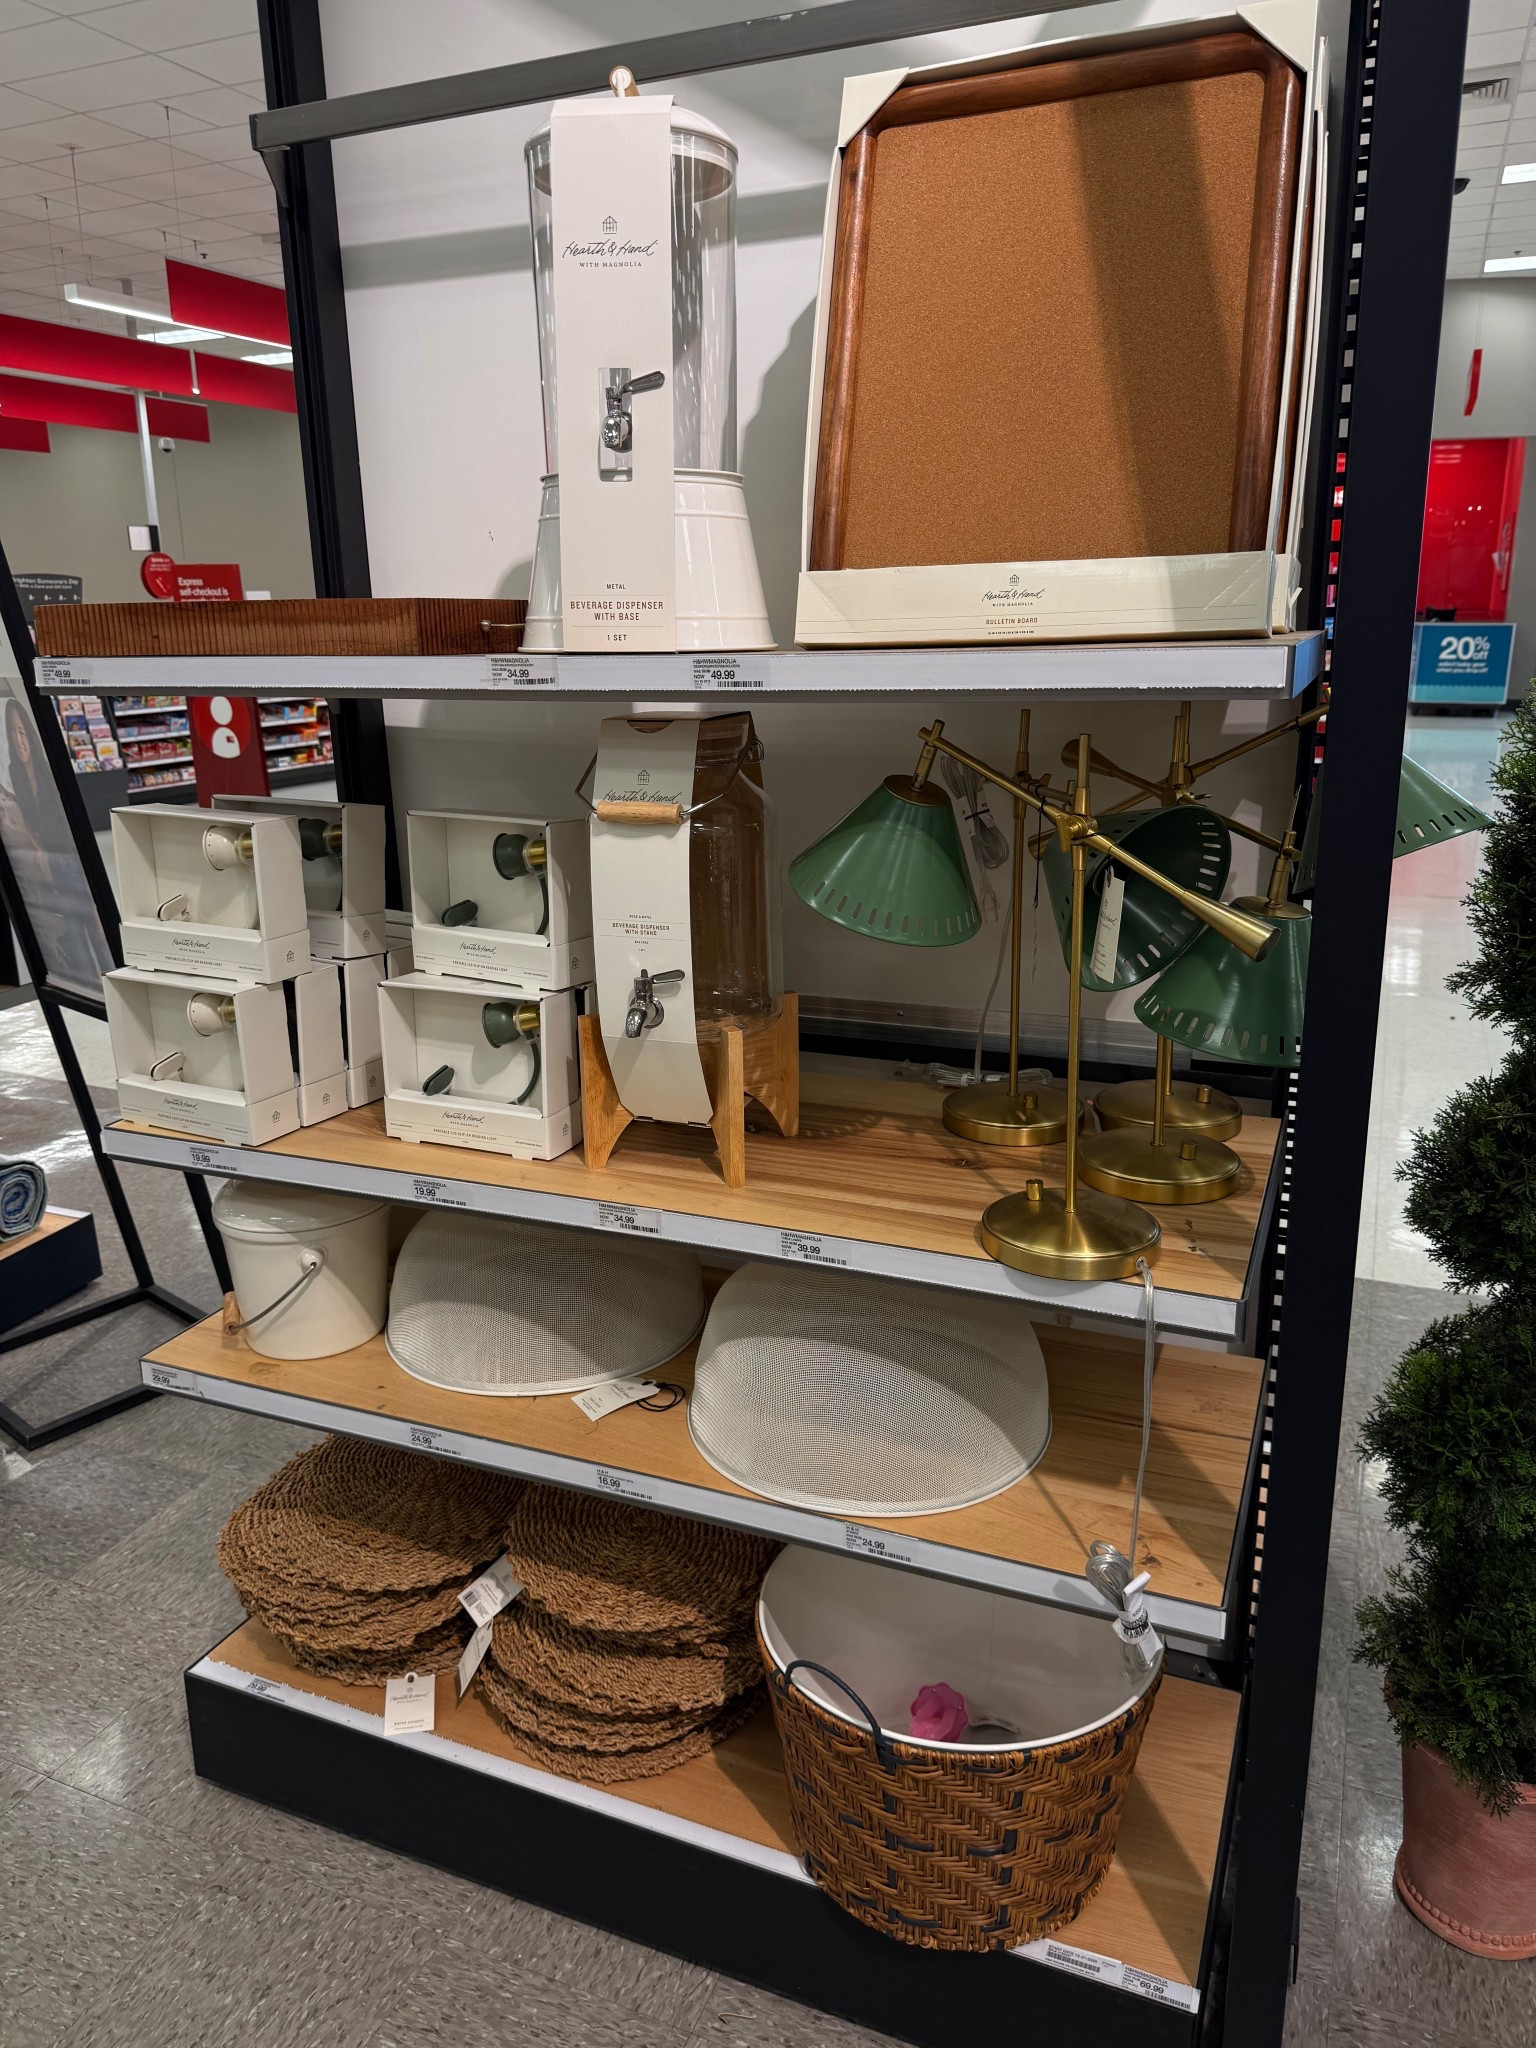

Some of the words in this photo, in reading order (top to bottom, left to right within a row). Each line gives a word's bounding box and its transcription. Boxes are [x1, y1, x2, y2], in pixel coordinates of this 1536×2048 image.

[562, 239, 607, 258] Hearth
[608, 241, 616, 257] &
[616, 240, 658, 257] Hand
[177, 577, 203, 587] Express
[179, 587, 222, 596] self-checkout
[222, 588, 229, 596] is
[982, 588, 1011, 602] Hearth
[1011, 589, 1018, 600] &
[1018, 588, 1045, 600] Hand
[570, 601, 613, 610] BEVERAGE
[616, 601, 664, 610] DISPENSER
[594, 612, 616, 621] WITH
[619, 612, 640, 621] BASE
[1438, 635, 1491, 661] 20%
[1472, 651, 1489, 661] off
[54, 669, 71, 678] 49.99
[507, 669, 530, 678] 34.99
[710, 670, 736, 680] 49.99
[602, 789, 638, 803] Hearth
[640, 791, 647, 802] &
[647, 790, 683, 805] Hand
[640, 923, 670, 931] DISPENSER
[191, 1153, 211, 1163] 19.99
[414, 1187, 436, 1197] 19.99
[613, 1214, 635, 1224] 34.99
[797, 1243, 821, 1255] 39.99
[411, 1434, 432, 1445] 24.99
[598, 1476, 620, 1488] 16.99
[862, 1538, 885, 1550] 24.99
[1048, 1944, 1063, 1952] START
[1139, 1980, 1164, 1994] 69.99
